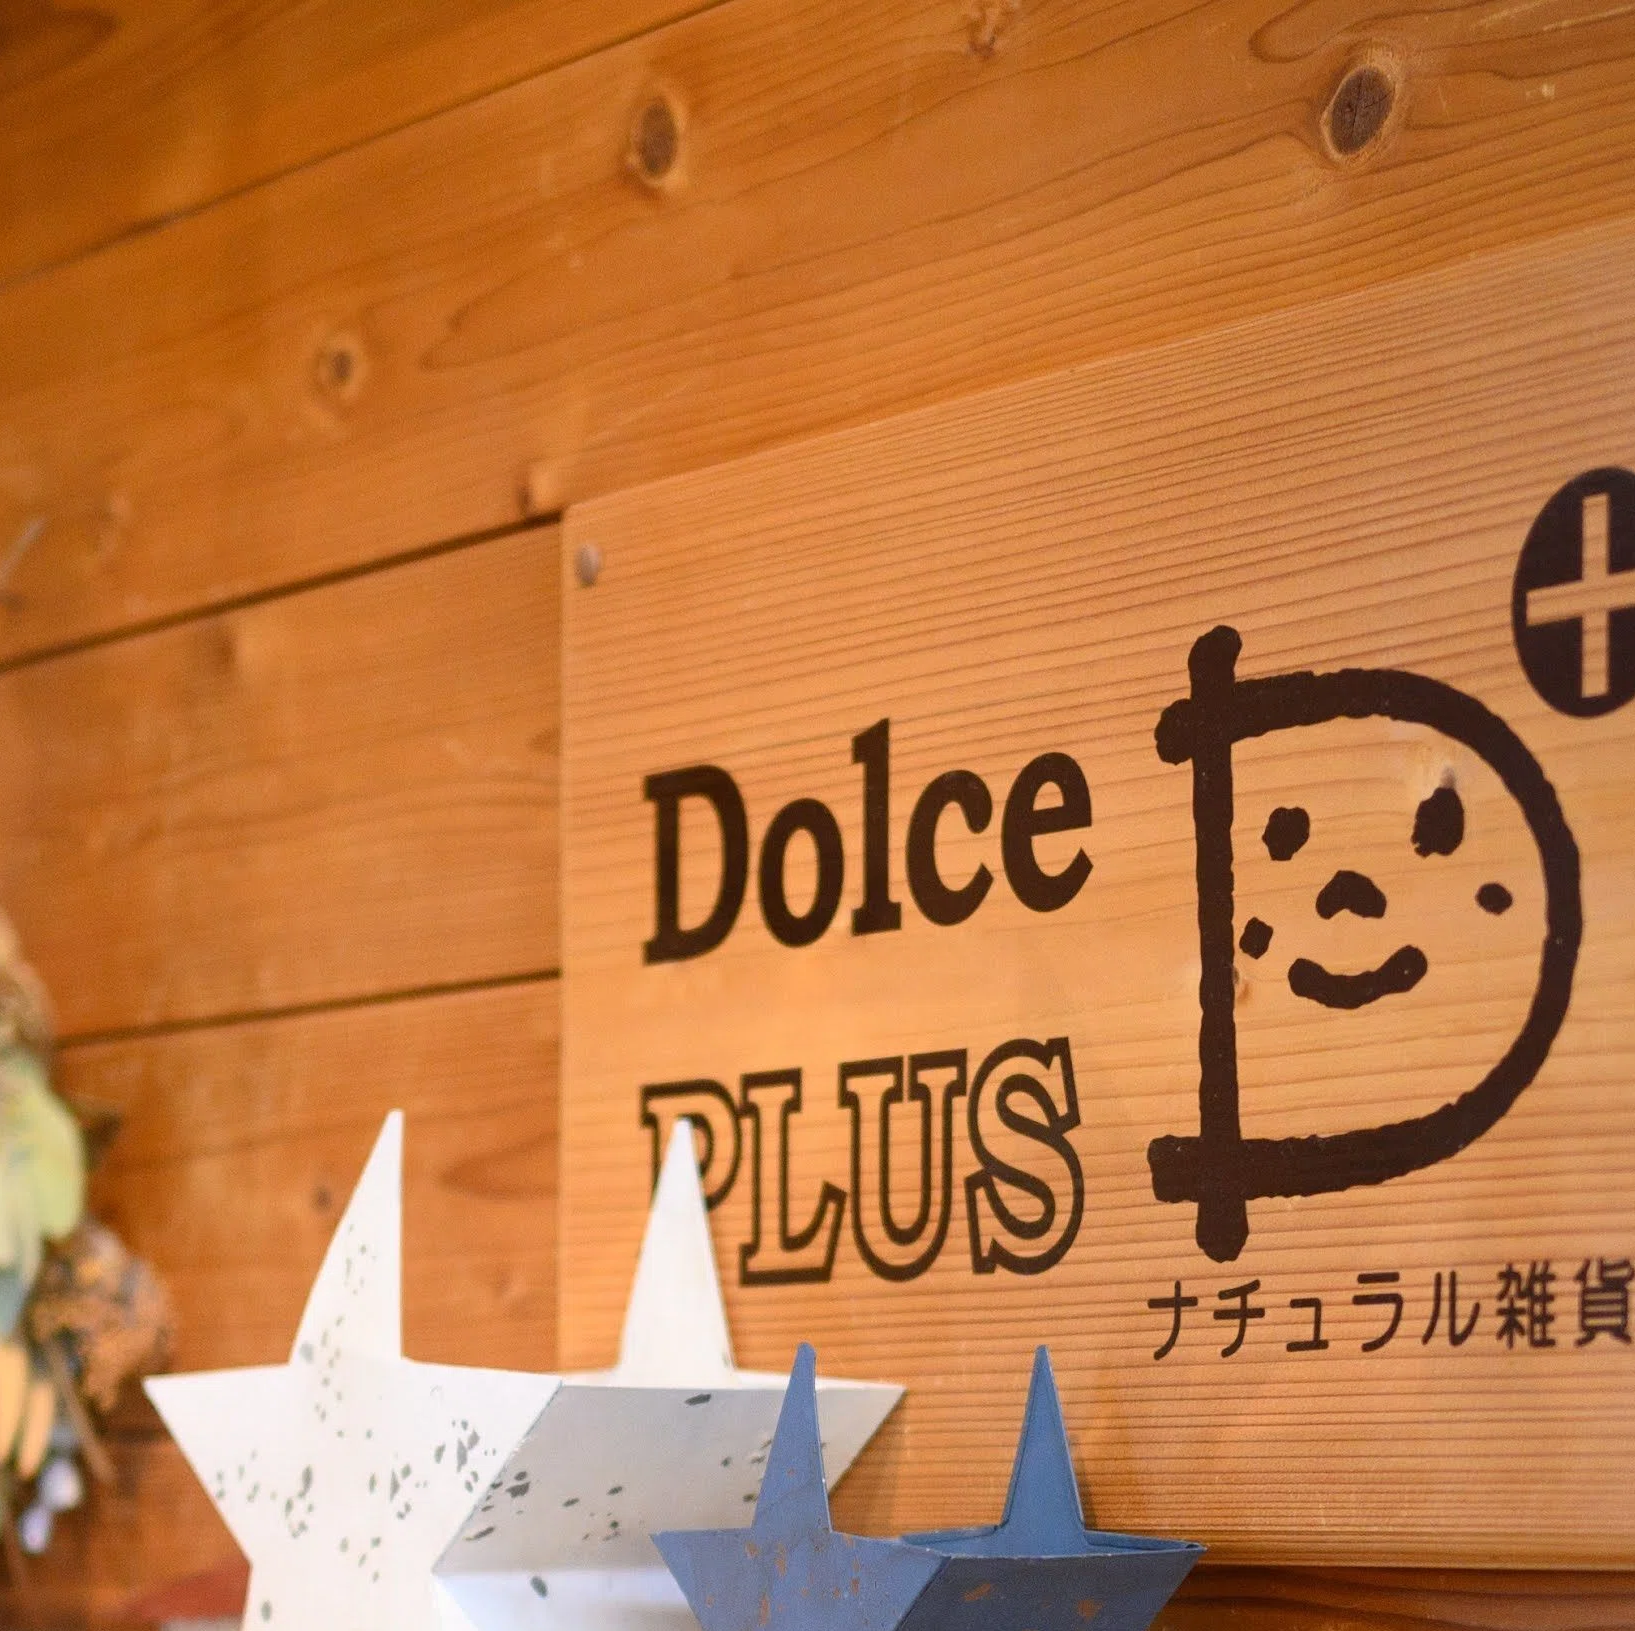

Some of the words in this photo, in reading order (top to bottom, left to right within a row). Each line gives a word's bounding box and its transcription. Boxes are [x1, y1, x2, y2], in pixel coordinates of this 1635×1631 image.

[643, 717, 1093, 964] Dolce
[1147, 1256, 1635, 1360] ナチュラル雑貨
